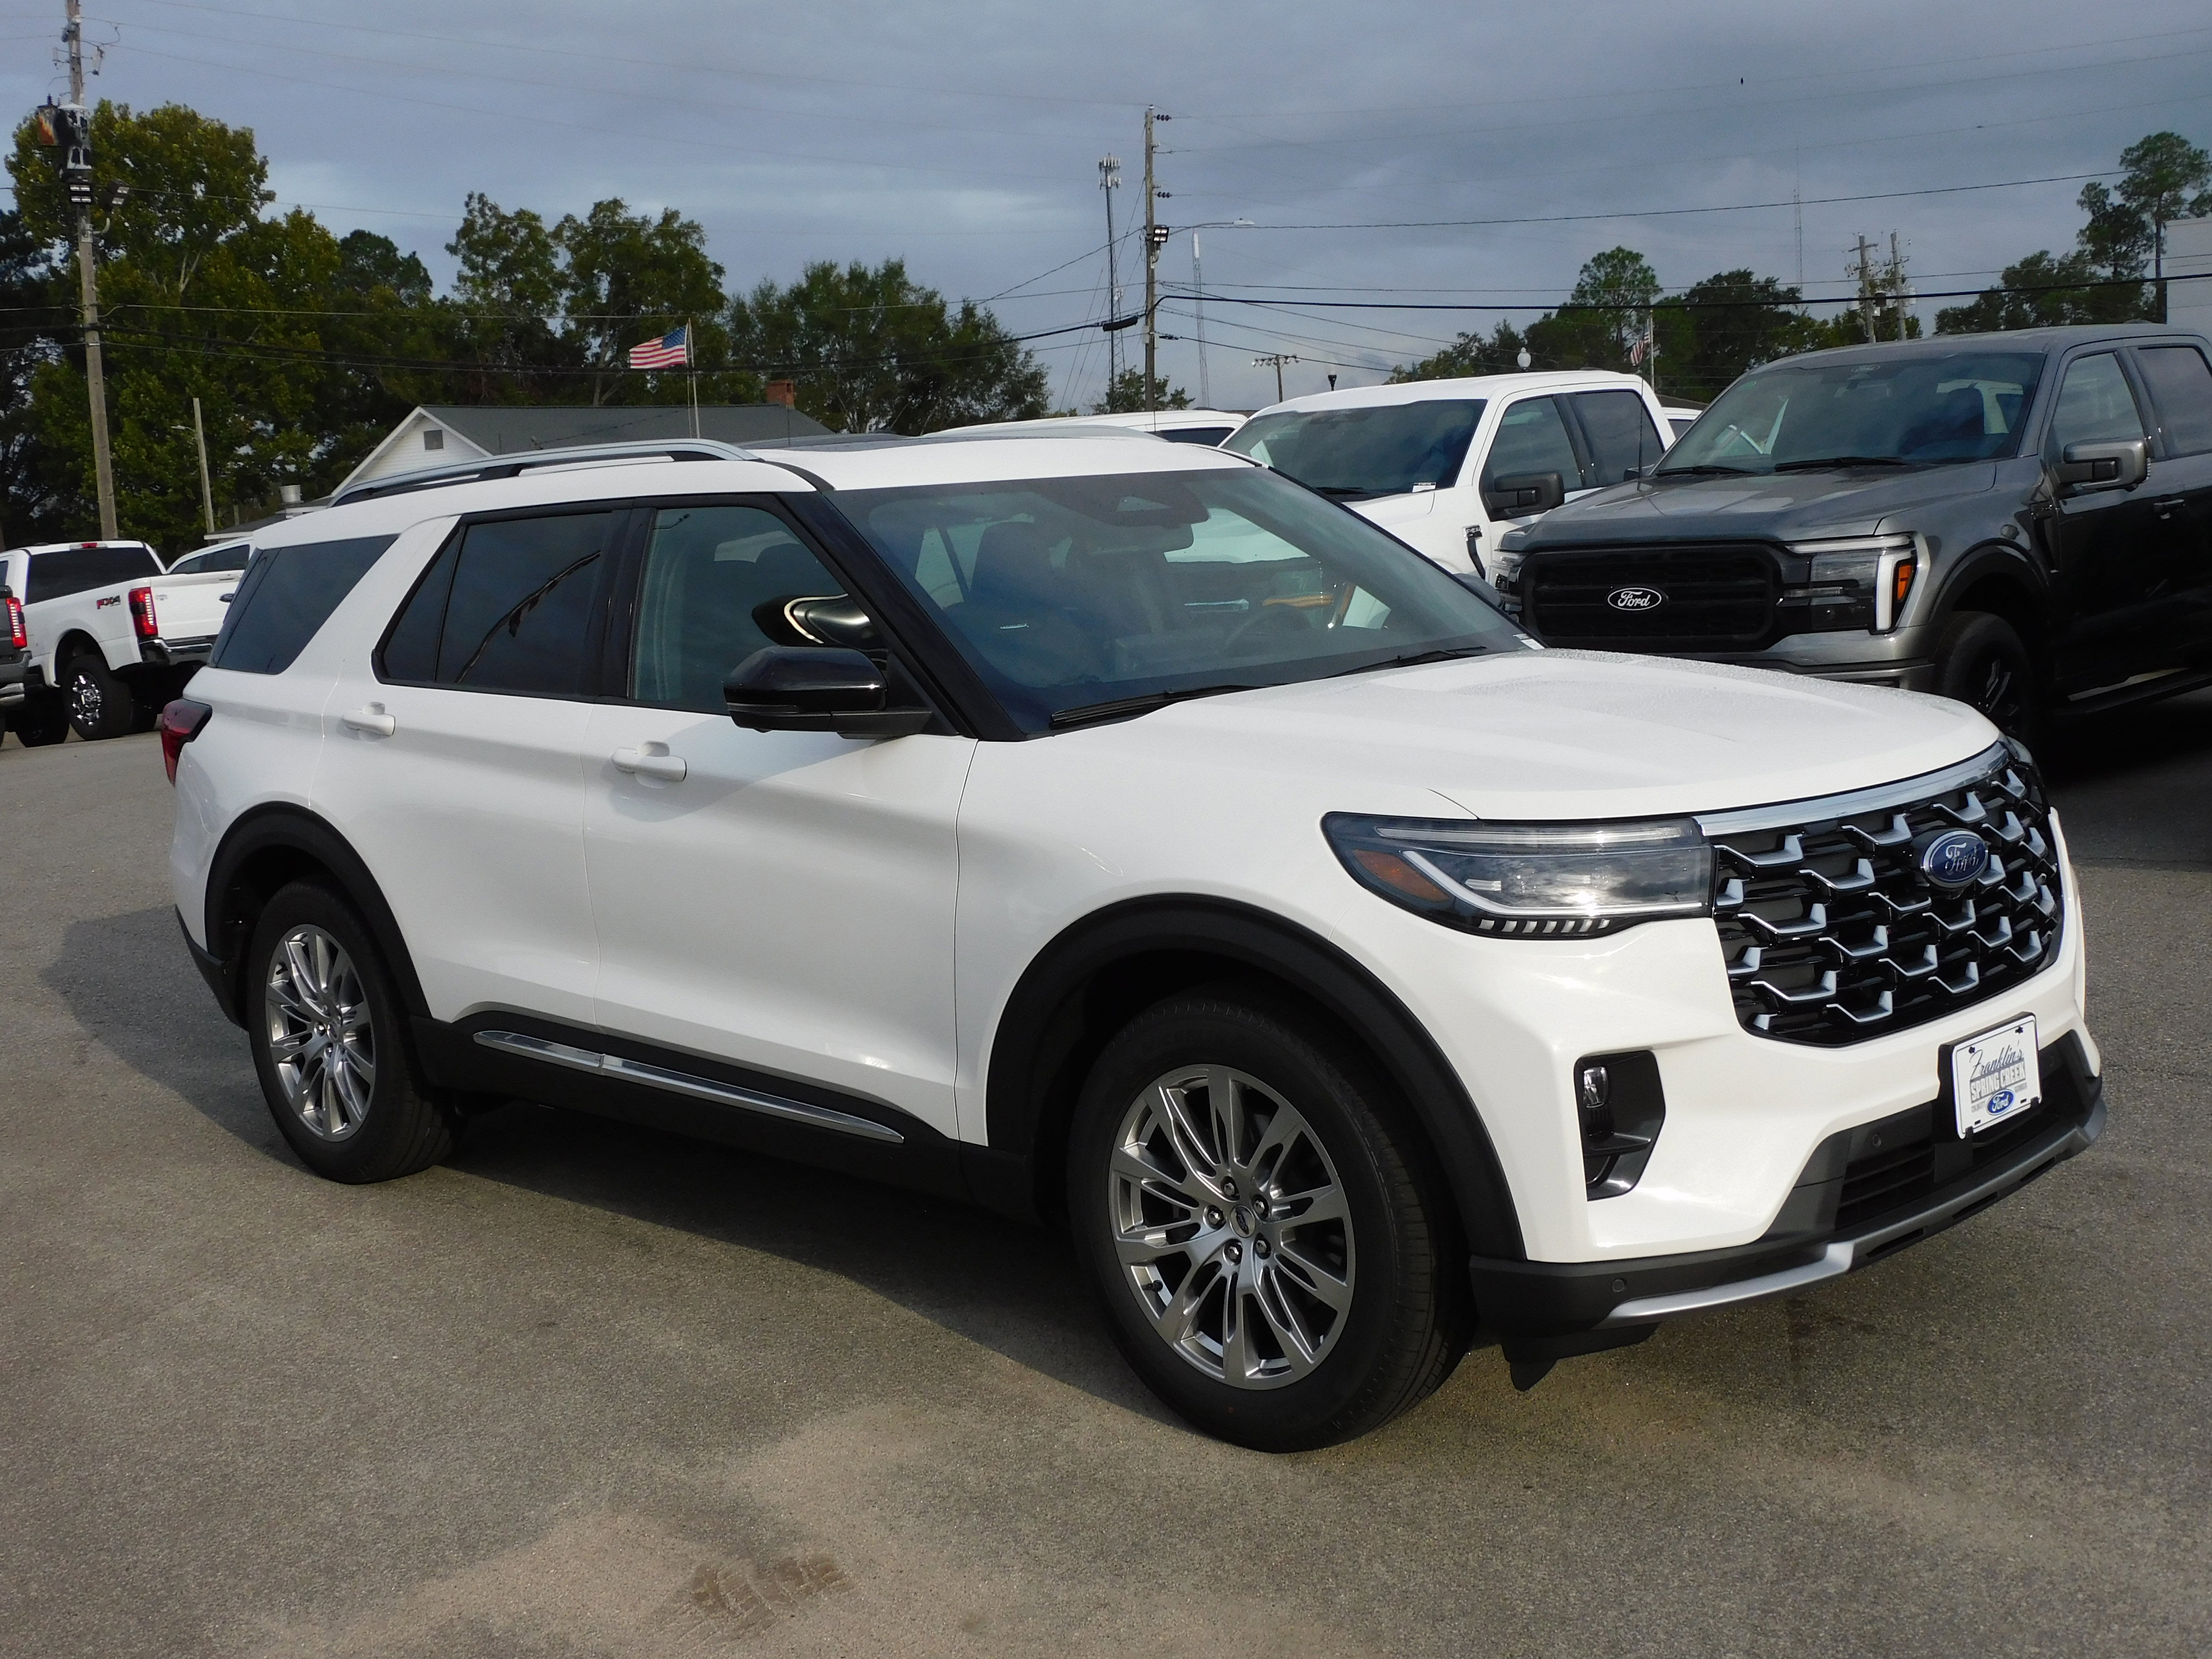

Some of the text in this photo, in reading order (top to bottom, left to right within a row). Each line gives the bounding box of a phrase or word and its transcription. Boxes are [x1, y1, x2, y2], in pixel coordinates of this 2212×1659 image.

[96, 595, 120, 610] FX4
[1618, 591, 1650, 606] Ford
[1945, 842, 1979, 875] Ford
[1969, 1039, 2023, 1080] Franklin's
[1971, 1061, 2026, 1101] SPRING CREEK
[1992, 1093, 2010, 1112] Ford
